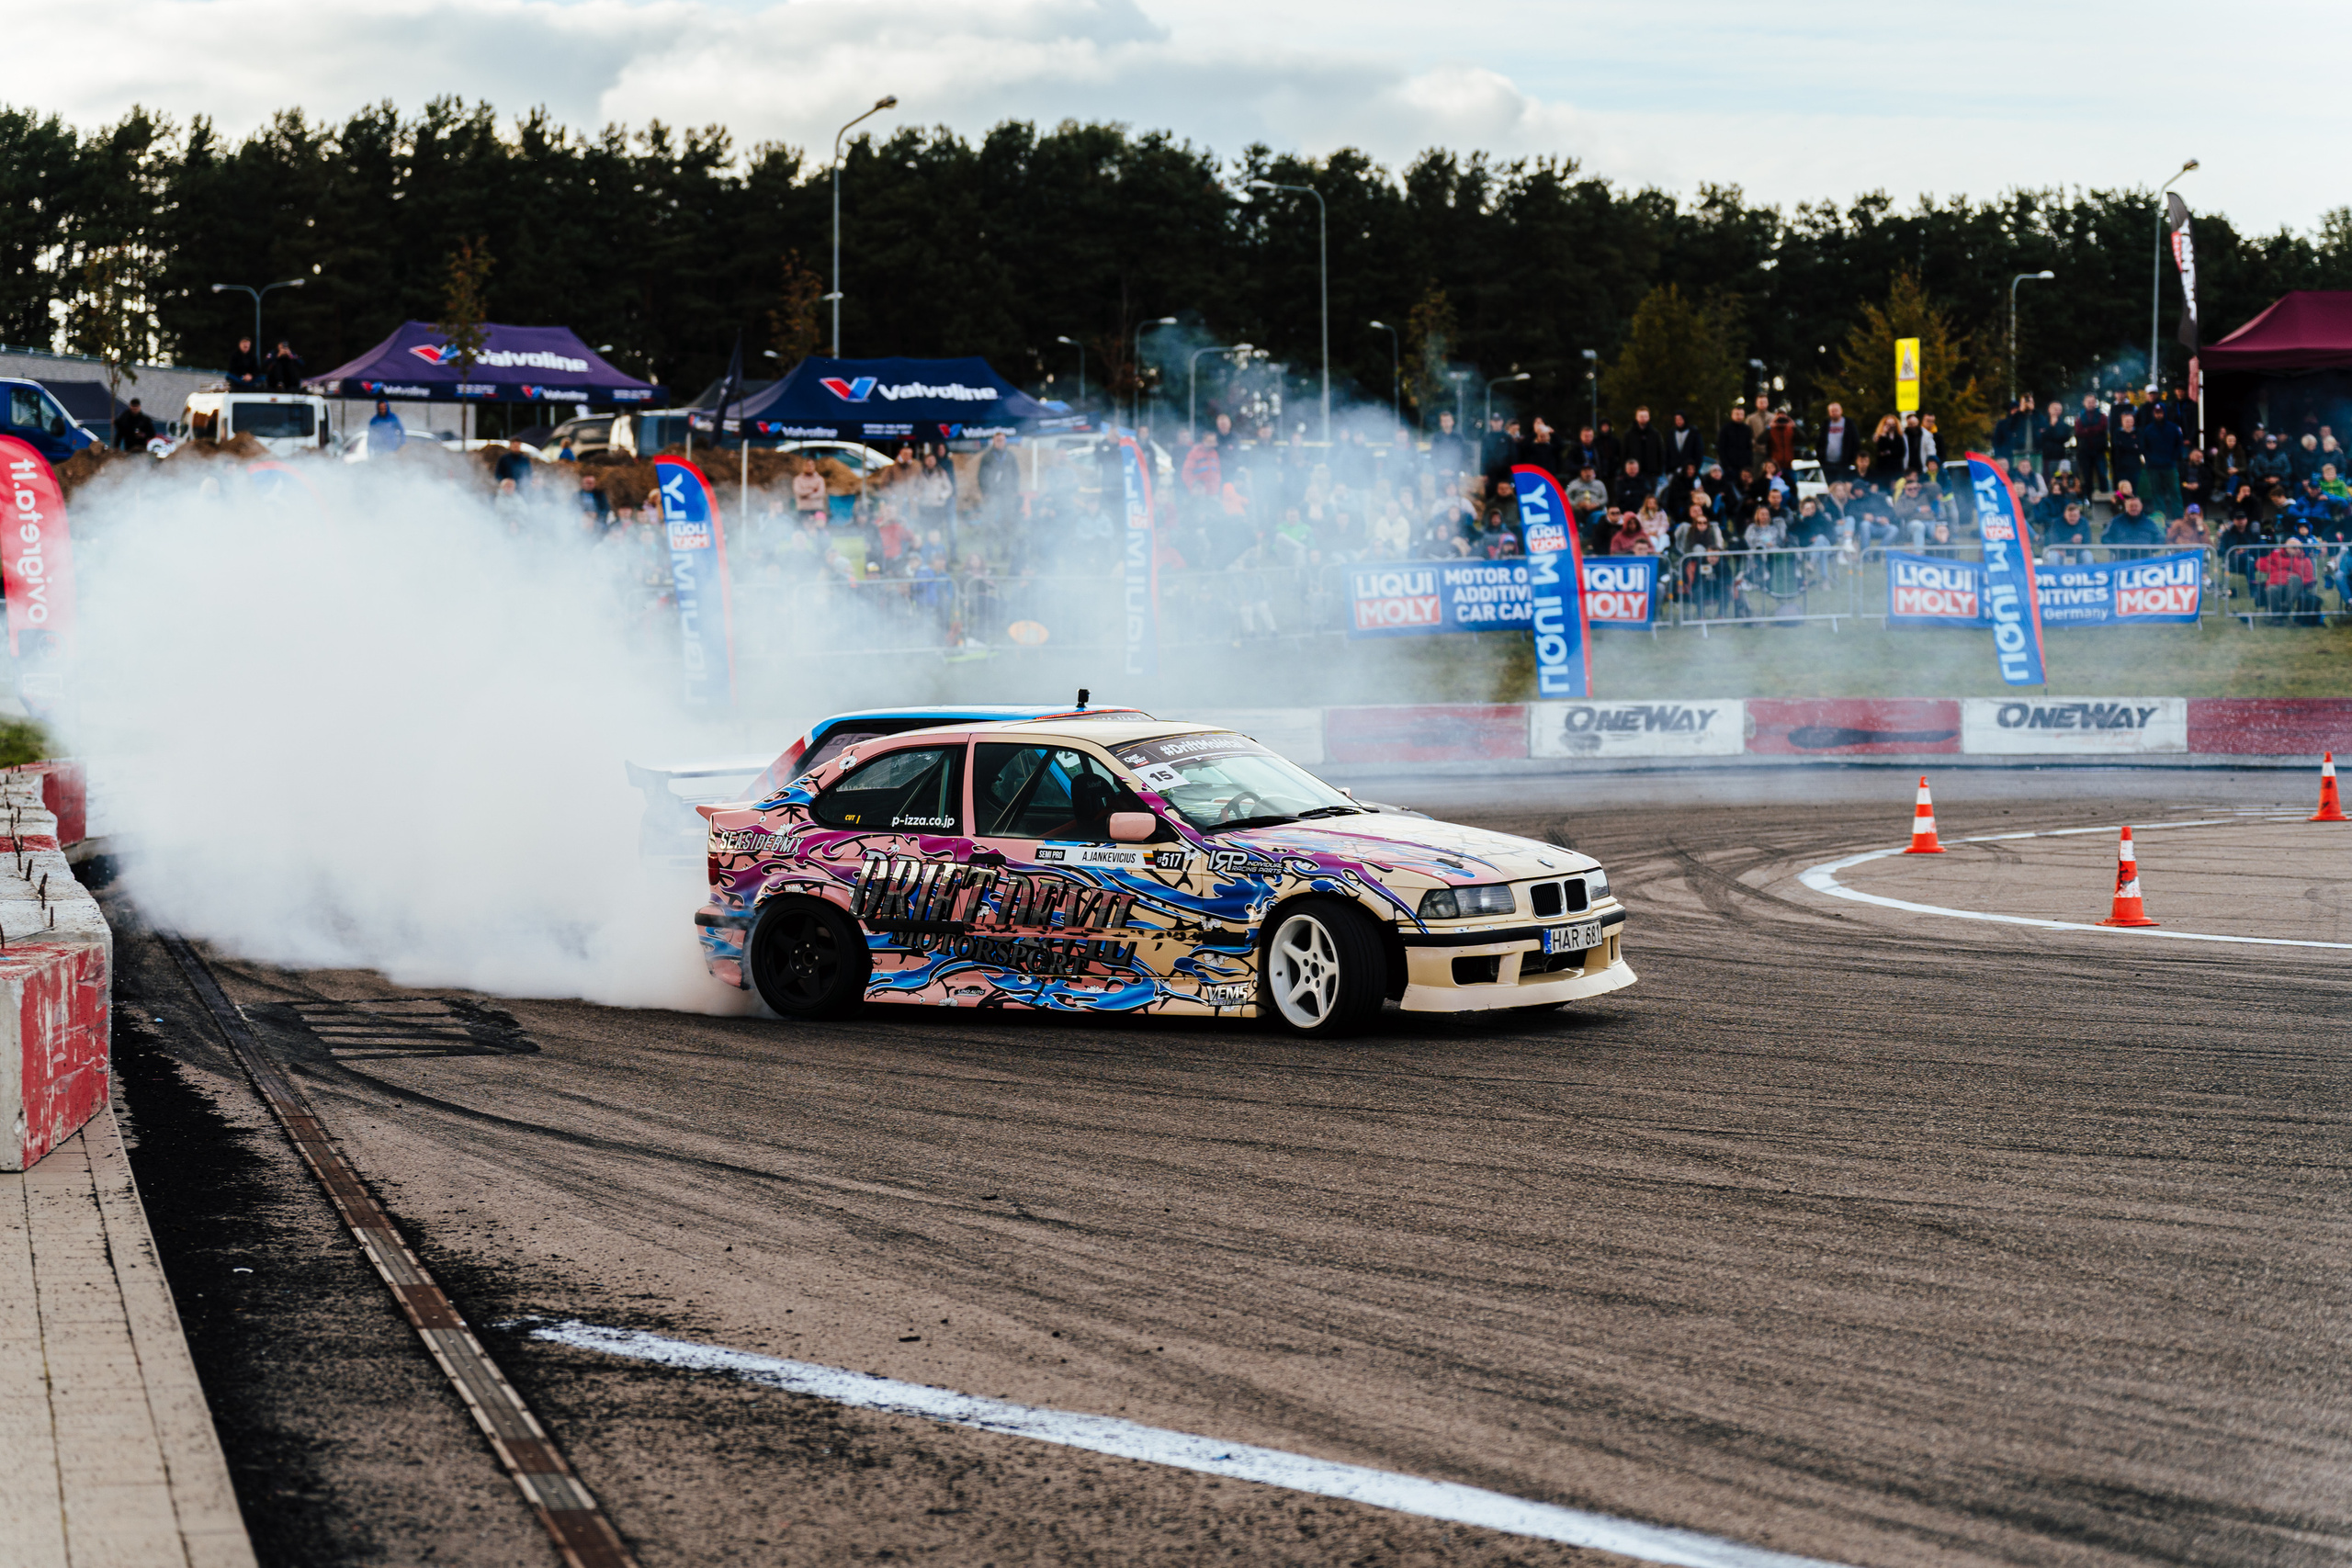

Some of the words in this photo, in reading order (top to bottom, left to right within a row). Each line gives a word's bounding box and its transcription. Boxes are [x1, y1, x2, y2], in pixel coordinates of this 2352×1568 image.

[877, 381, 998, 401] Valvoline
[782, 426, 838, 438] Valvoline
[1355, 571, 1434, 598] LIQUI
[1444, 567, 1511, 585] MOTOR
[1513, 567, 1528, 583] O
[1582, 567, 1645, 592] IQUI
[1896, 564, 1973, 590] LIQUI
[2061, 570, 2109, 586] OILS
[2120, 563, 2194, 590] LIQUI
[1453, 585, 1532, 604] ADDITIV
[1898, 587, 1975, 616] MOLY
[2037, 587, 2109, 605] DITIVES
[2121, 586, 2197, 615] MOLY
[1359, 596, 1441, 626] MOLY
[1456, 604, 1496, 622] CAR
[2043, 608, 2109, 621] Germany
[1149, 770, 1174, 782] 15
[845, 814, 856, 822] CUT
[891, 815, 956, 829] p-izza.co.jp
[719, 830, 806, 854] SEASIDEBMX
[1081, 851, 1136, 863] A.JANKEVICIUS
[1247, 861, 1283, 869] INDIVIDUAL
[1552, 928, 1580, 951] HAR
[1585, 923, 1602, 945] 681
[888, 930, 1088, 976] MOTORSPORT
